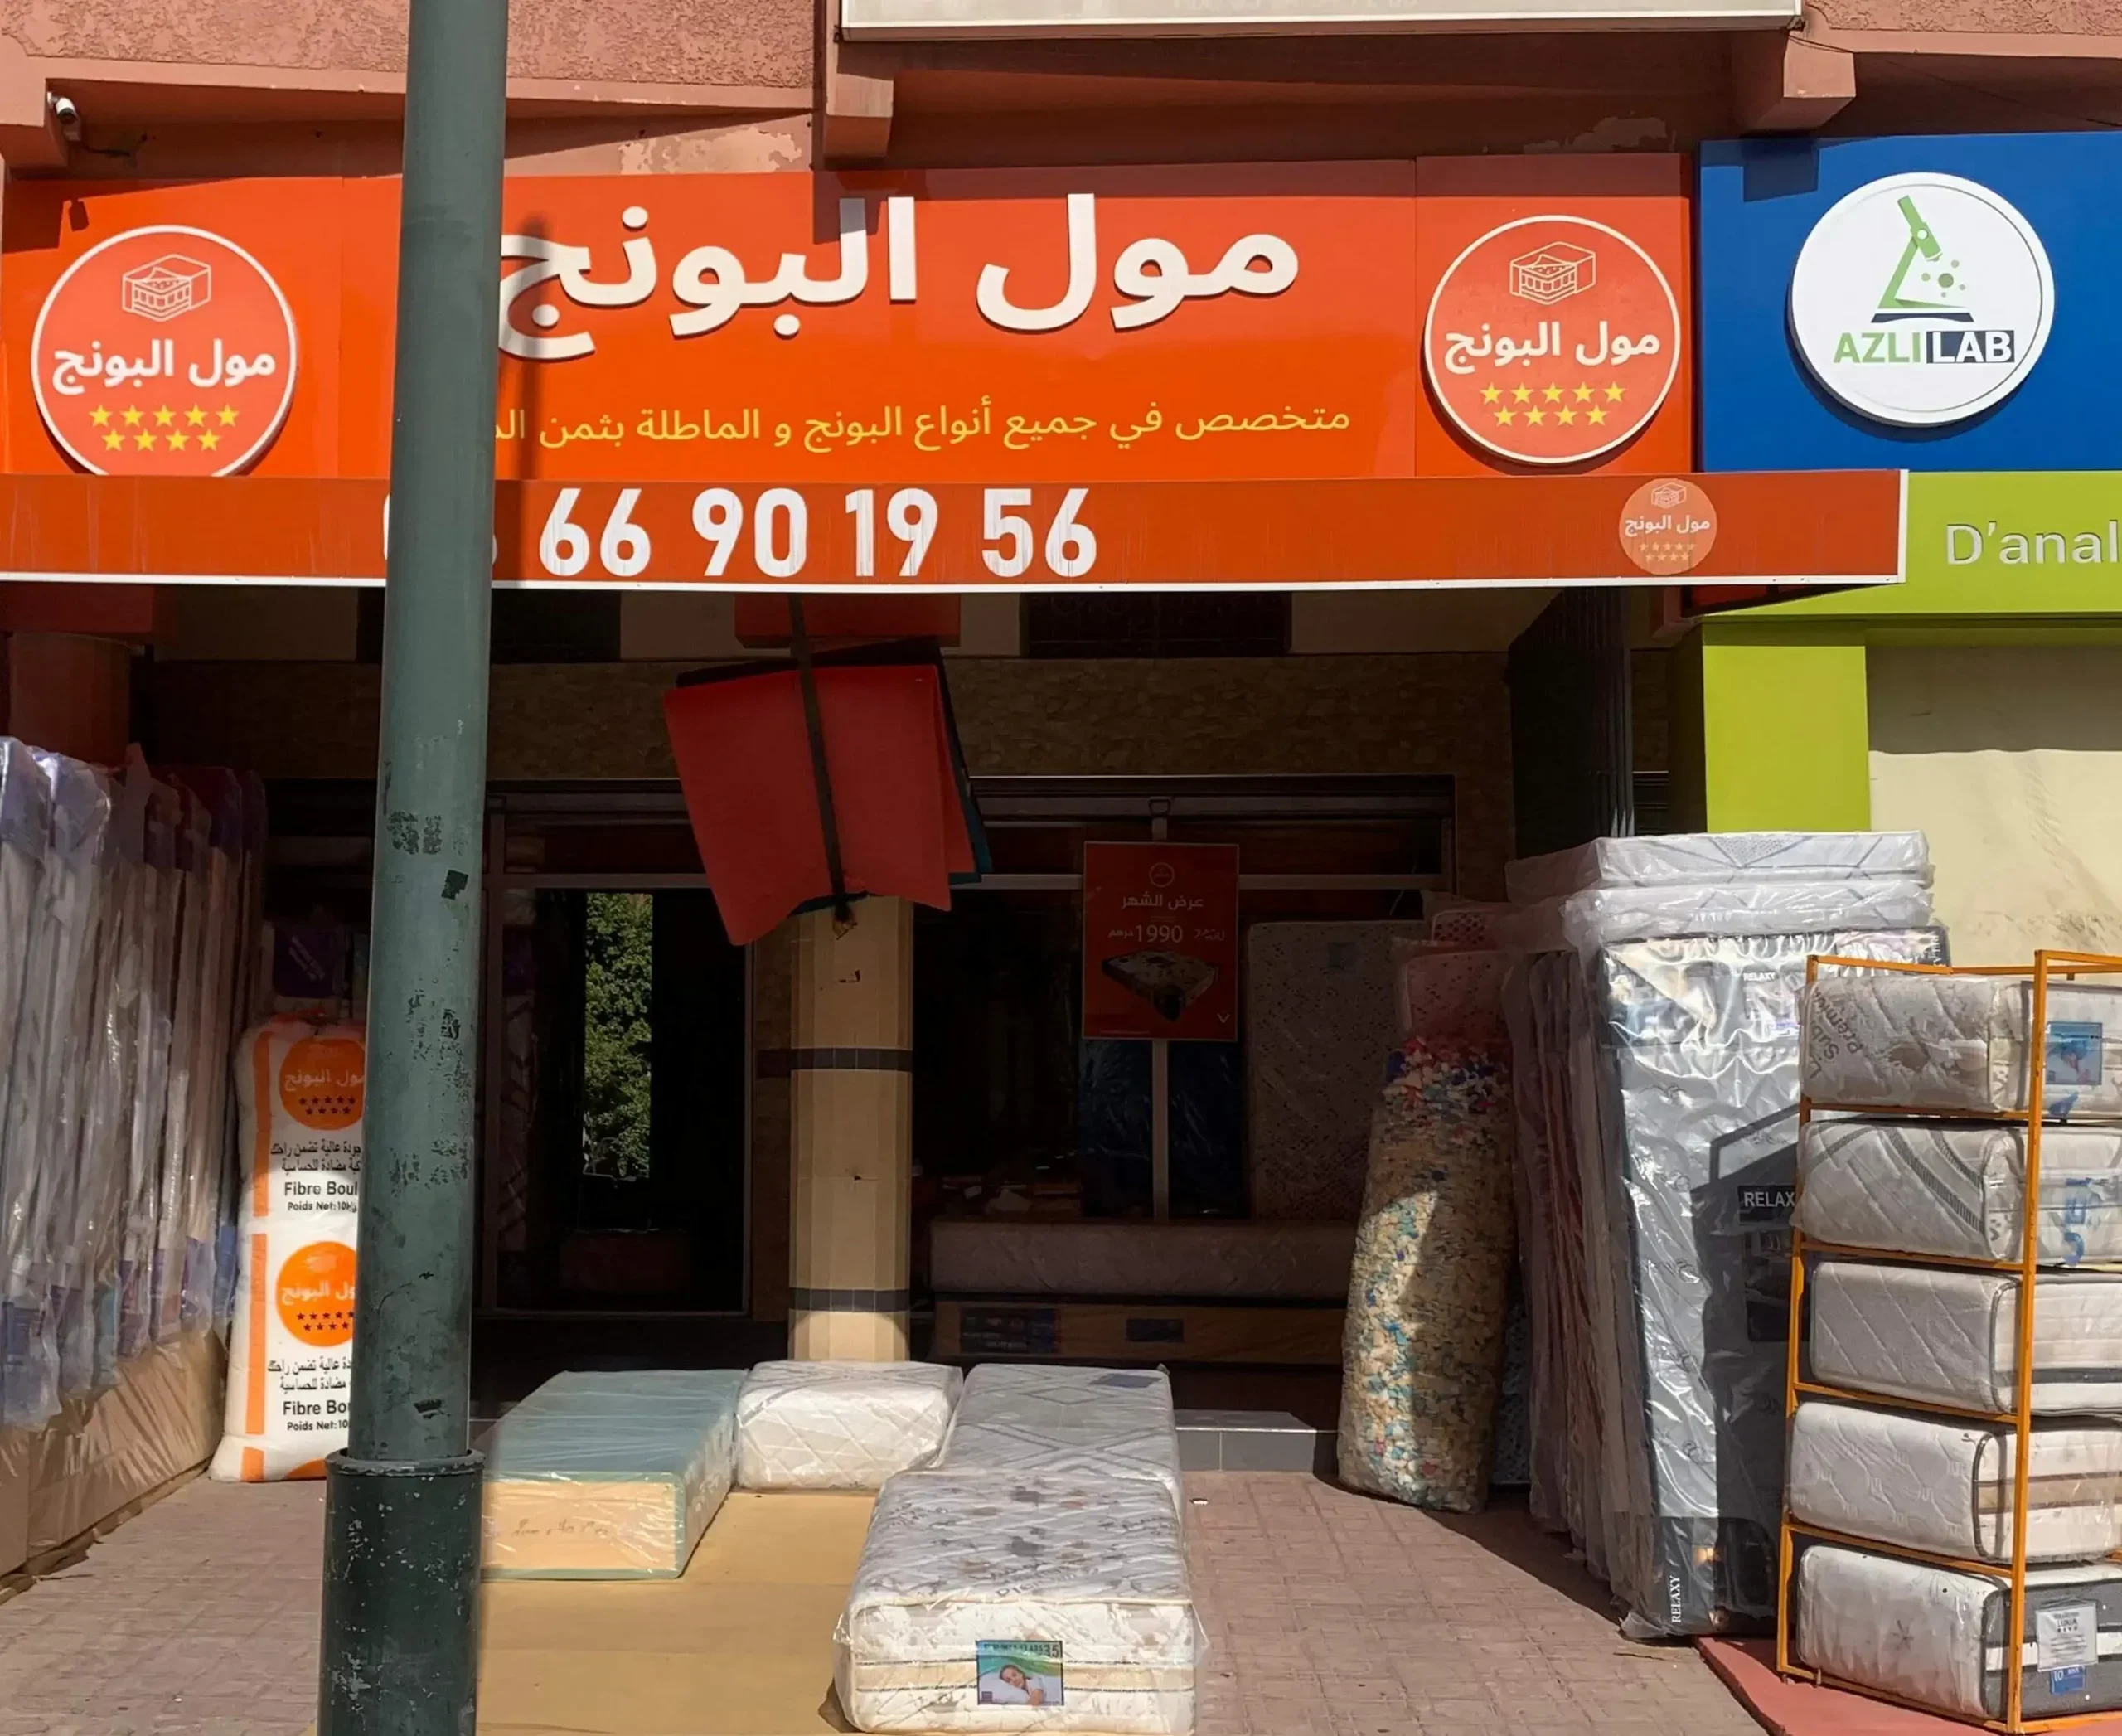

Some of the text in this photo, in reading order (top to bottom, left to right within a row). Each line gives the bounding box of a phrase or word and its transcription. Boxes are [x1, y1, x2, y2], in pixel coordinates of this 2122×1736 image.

[498, 192, 1299, 360] مول البونج
[1444, 321, 1660, 374] مول البونج
[51, 338, 276, 395] مول البونج
[539, 411, 624, 449] بثمن
[637, 409, 759, 440] الماطلة
[775, 424, 790, 444] و
[803, 405, 902, 453] البونج
[913, 395, 991, 450] أنواع
[1003, 411, 1097, 449] جميع
[1110, 401, 1163, 449] في
[1175, 405, 1350, 440] متخصص
[539, 488, 652, 576] 66
[691, 487, 807, 577] 90
[845, 487, 938, 577] 19
[981, 487, 1097, 577] 56
[1625, 515, 1711, 536] مول البونج
[1121, 891, 1204, 910] عرض الشهر
[1135, 924, 1184, 943] 1990
[1743, 972, 1776, 982] RELAXY
[284, 1181, 321, 1195] Fibre
[288, 1201, 312, 1211] Poids
[283, 1399, 351, 1415] Fibre Bo
[287, 1421, 313, 1431] Poids
[1669, 1574, 1682, 1623] RELAXY
